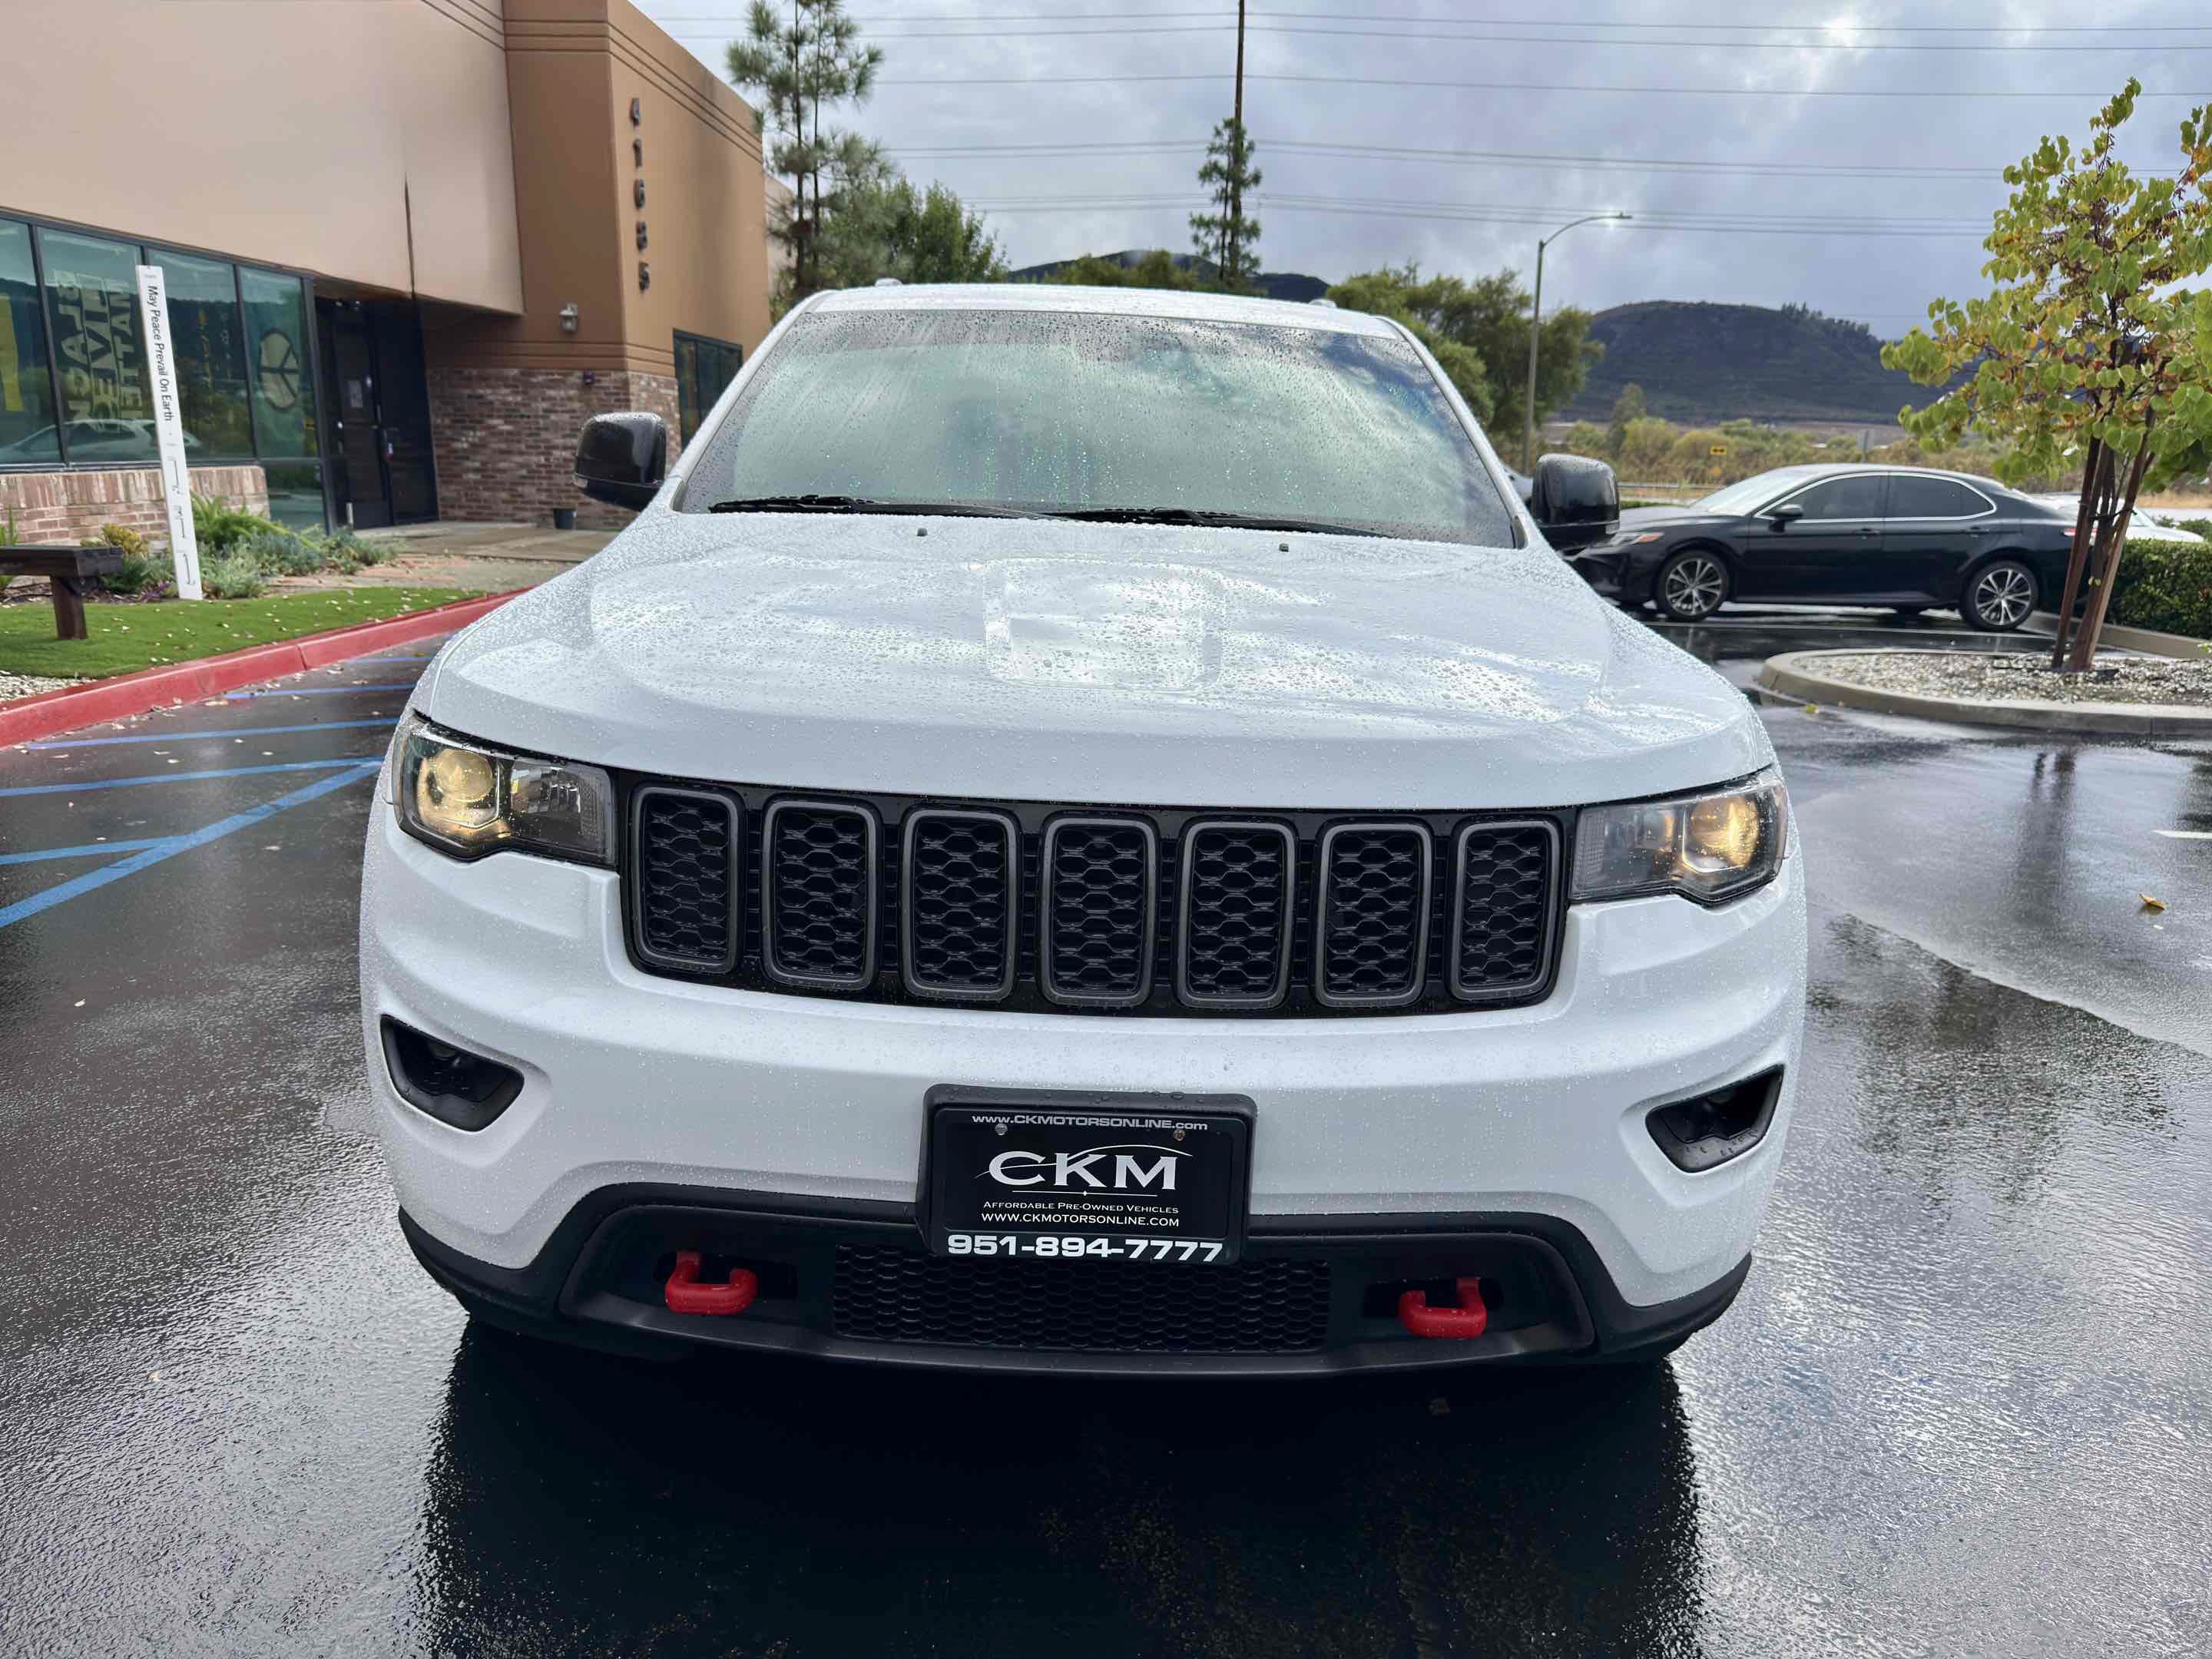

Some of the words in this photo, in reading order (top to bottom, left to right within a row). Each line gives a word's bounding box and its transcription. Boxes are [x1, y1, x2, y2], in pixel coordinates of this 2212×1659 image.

[147, 285, 158, 307] May
[151, 309, 161, 340] Peace
[154, 343, 167, 376] Prevail
[160, 378, 169, 392] On
[161, 394, 174, 421] Earth
[972, 1114, 1208, 1131] www.CKMOTORSONLINE.com
[988, 1151, 1178, 1190] CKM
[981, 1213, 1180, 1227] WWW.CKMOTORSONLINE.COM
[947, 1233, 1224, 1263] 951-894-7777
